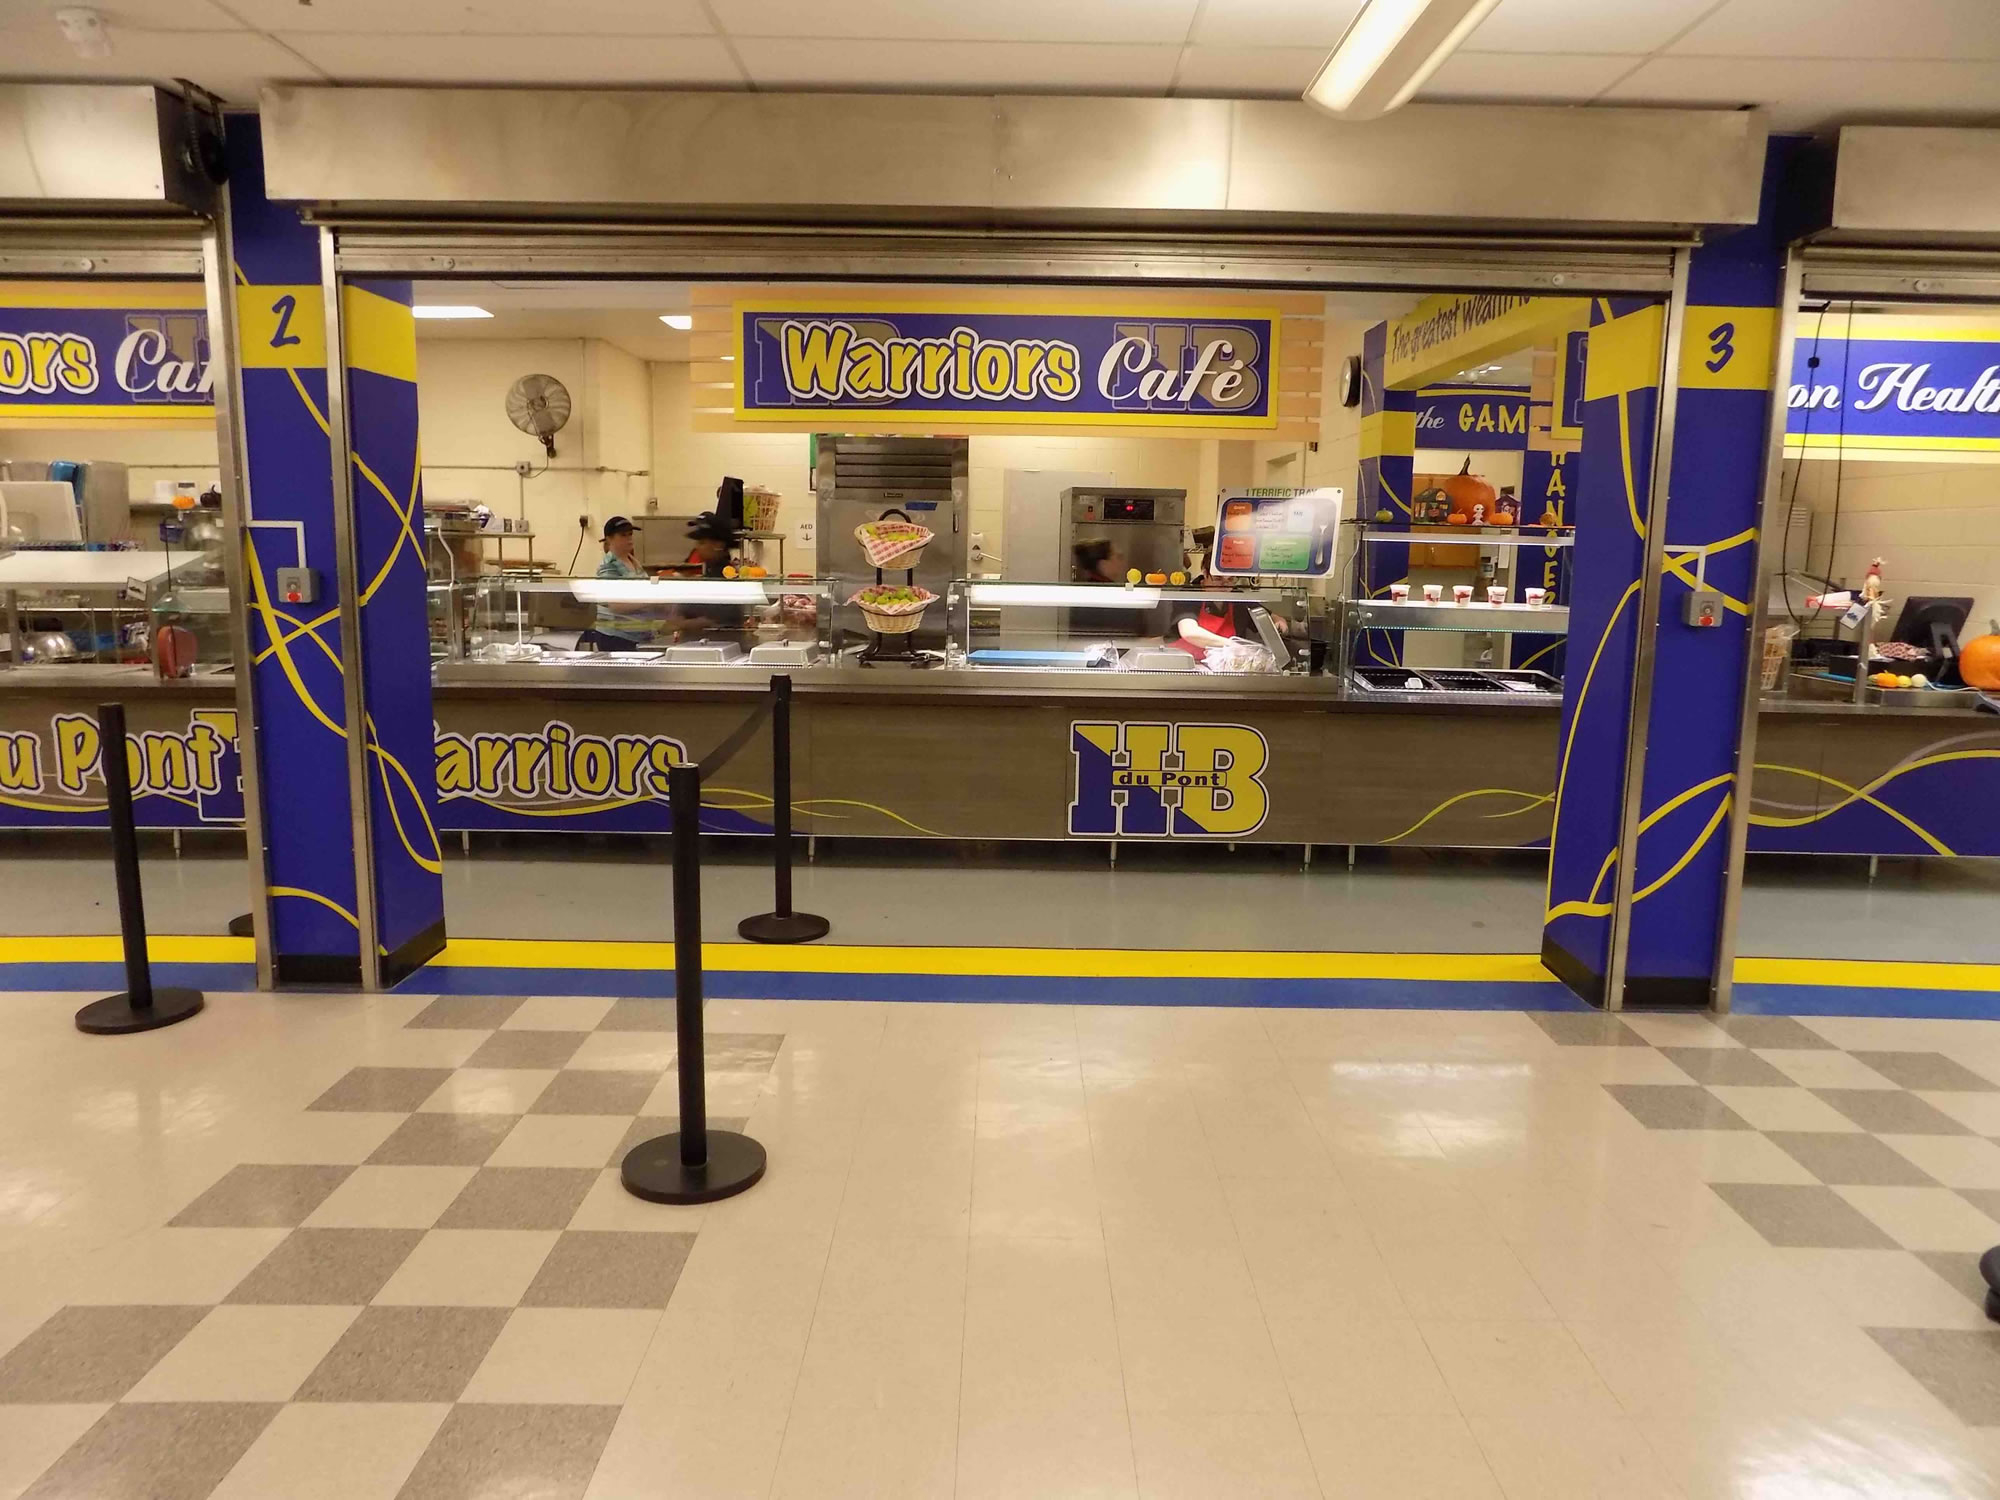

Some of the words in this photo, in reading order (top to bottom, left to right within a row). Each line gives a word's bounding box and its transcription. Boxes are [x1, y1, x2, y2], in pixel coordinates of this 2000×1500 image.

[270, 295, 301, 348] 2
[1392, 324, 1410, 364] The
[1411, 298, 1460, 362] greatest
[780, 319, 1080, 402] Warriors
[1098, 336, 1244, 402] Café
[1705, 322, 1734, 373] 3
[1854, 362, 2000, 413] Healt
[1416, 405, 1446, 430] the
[1251, 488, 1291, 498] TERRIFIC
[433, 719, 687, 800] arriors
[1119, 771, 1149, 785] du
[1162, 772, 1220, 786] Pont
